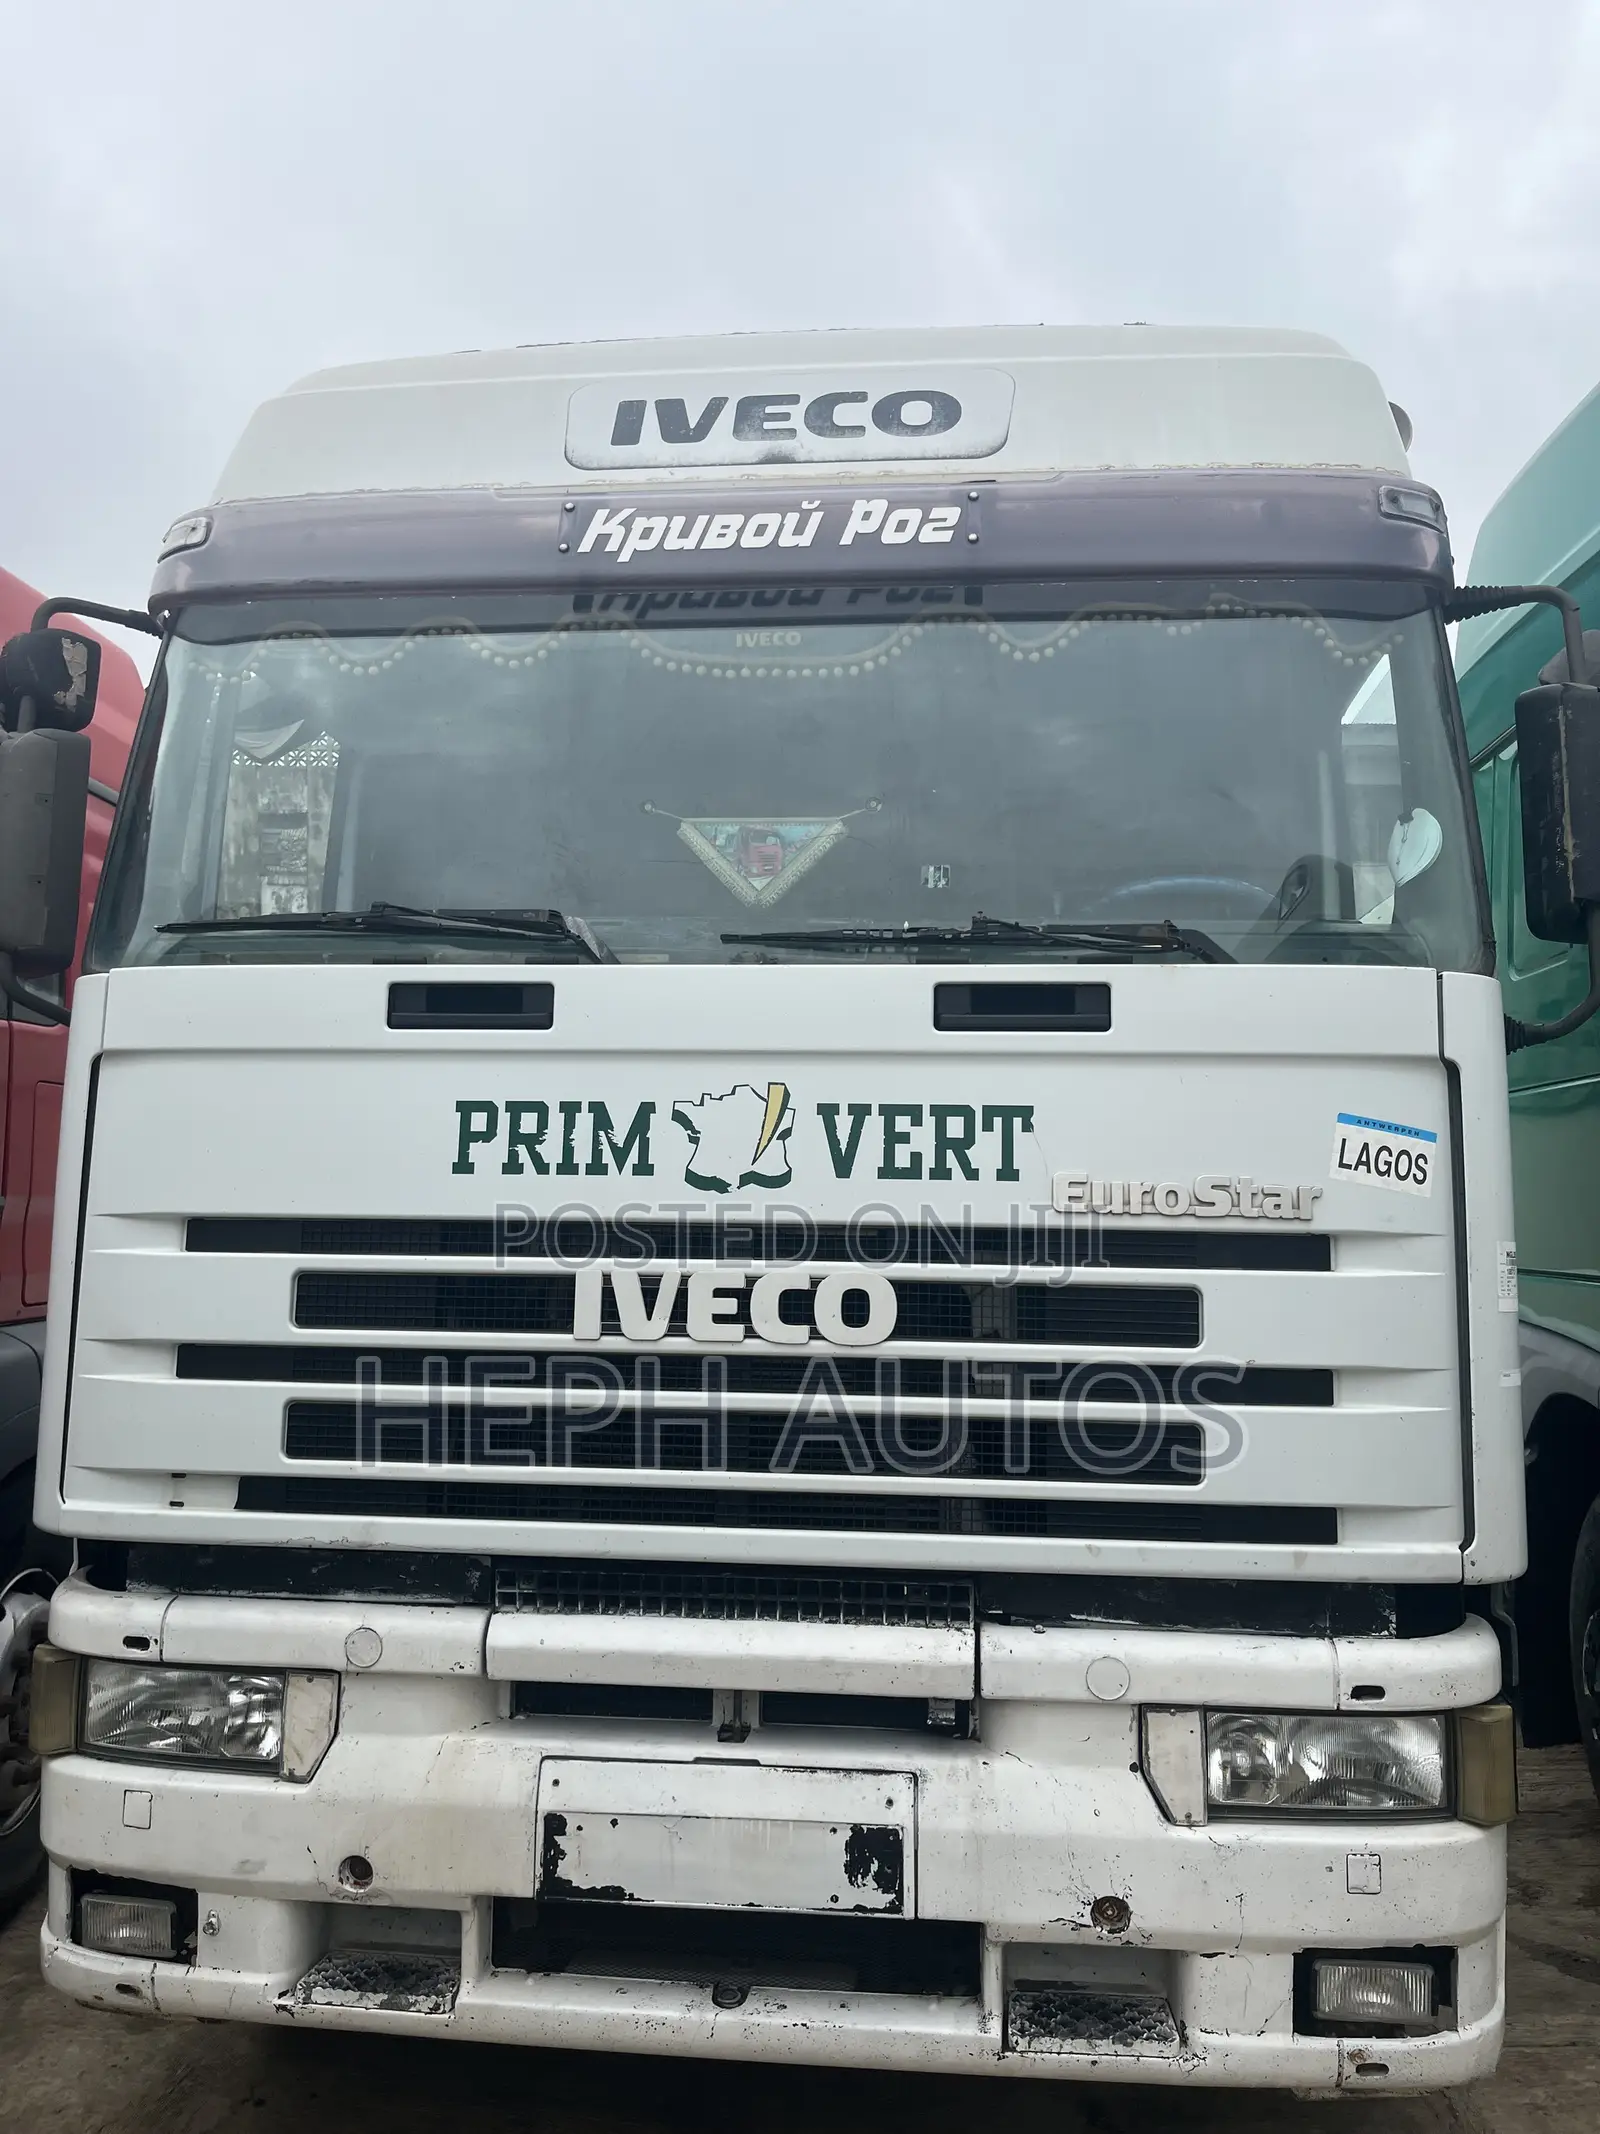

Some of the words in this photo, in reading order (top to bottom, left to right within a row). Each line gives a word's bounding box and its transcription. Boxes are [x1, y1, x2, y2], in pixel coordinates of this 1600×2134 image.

[610, 389, 963, 447] IVECO
[577, 500, 826, 563] Кривой
[838, 498, 963, 547] Рог
[735, 631, 802, 649] IVECO
[451, 1099, 657, 1177] PRIM
[816, 1102, 1035, 1182] VERT
[1356, 1119, 1420, 1137] ANTWERPEN
[1338, 1137, 1429, 1185] LAGOS
[1052, 1171, 1323, 1221] EuroStar
[573, 1269, 898, 1347] IVECO
